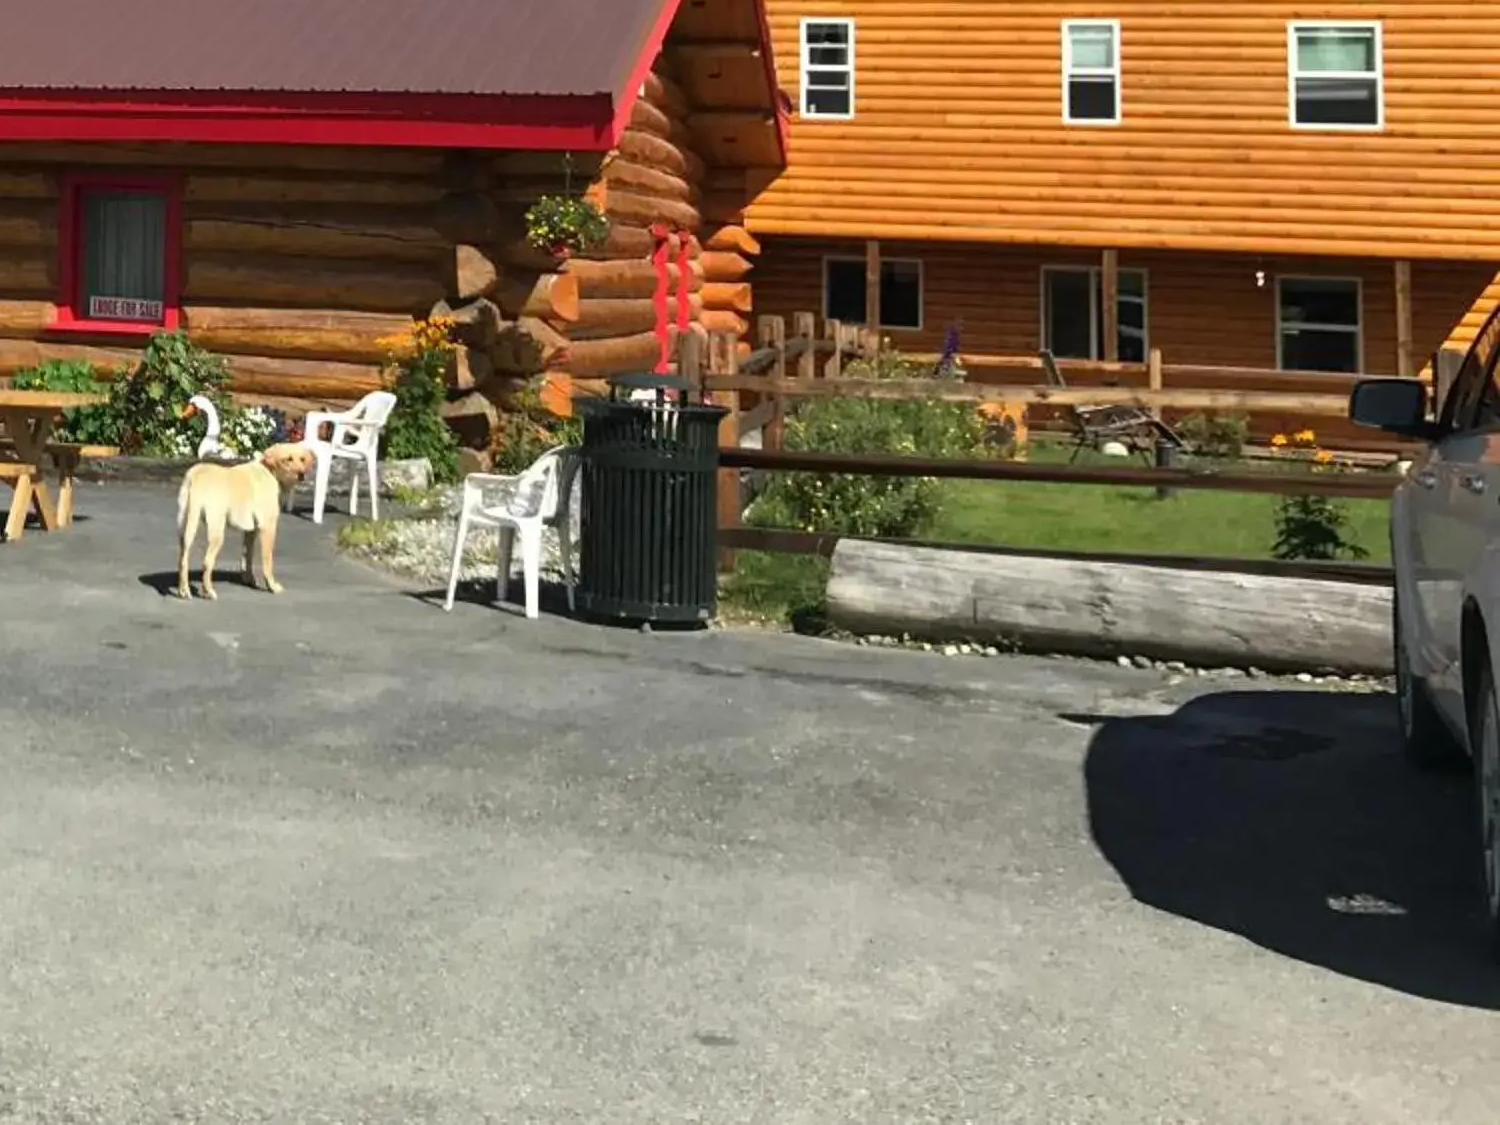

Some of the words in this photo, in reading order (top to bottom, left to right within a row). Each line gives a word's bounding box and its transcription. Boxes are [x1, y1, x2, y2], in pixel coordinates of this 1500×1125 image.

[94, 299, 118, 316] LODGE
[121, 300, 137, 317] FOR
[139, 302, 160, 318] SALE
